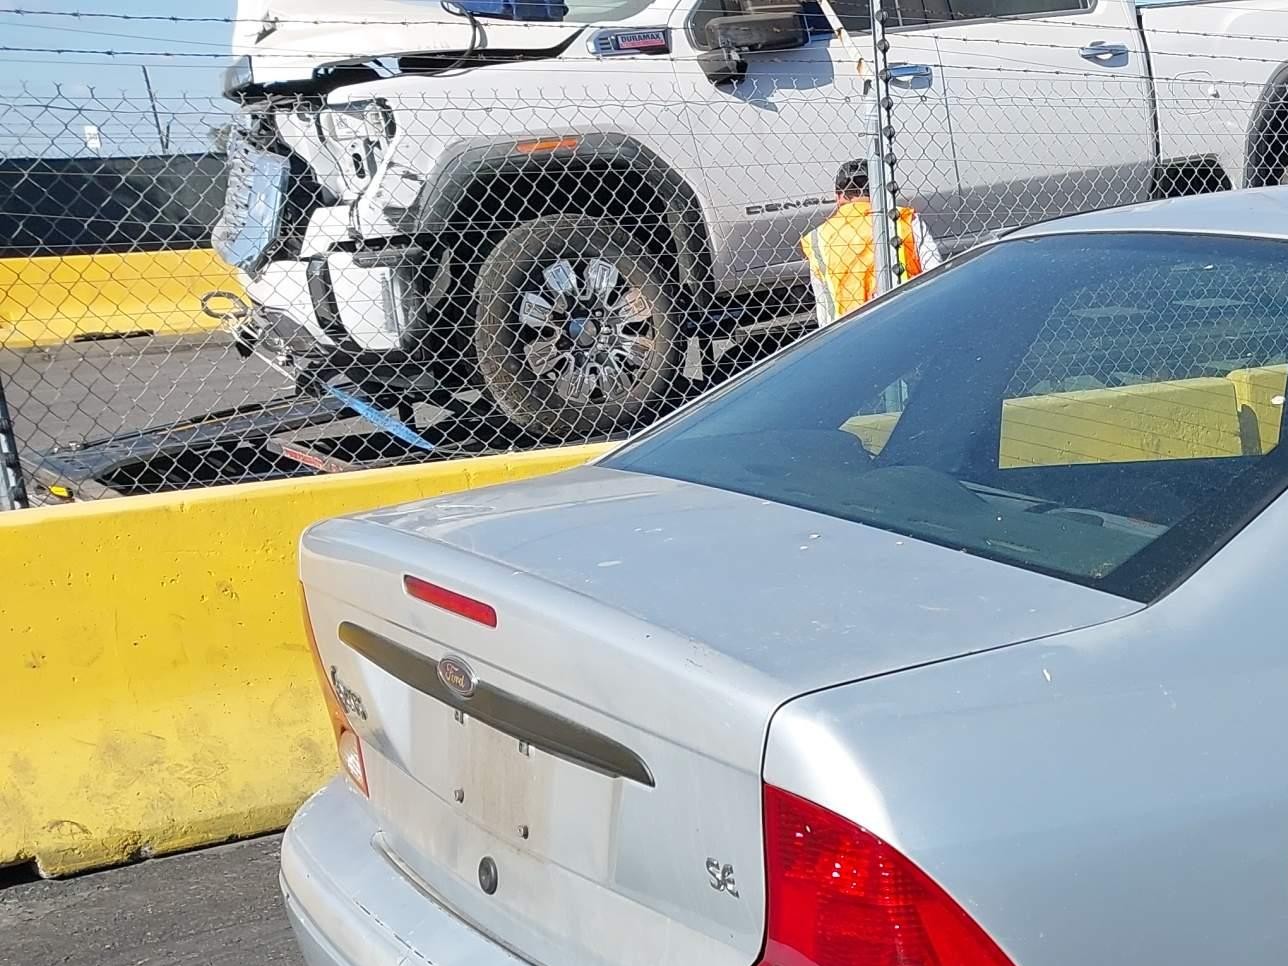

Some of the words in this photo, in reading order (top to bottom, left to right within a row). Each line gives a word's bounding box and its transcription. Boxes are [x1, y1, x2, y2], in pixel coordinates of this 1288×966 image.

[620, 32, 661, 43] DURAMAX
[745, 197, 836, 215] DENAL
[705, 856, 740, 899] SE
